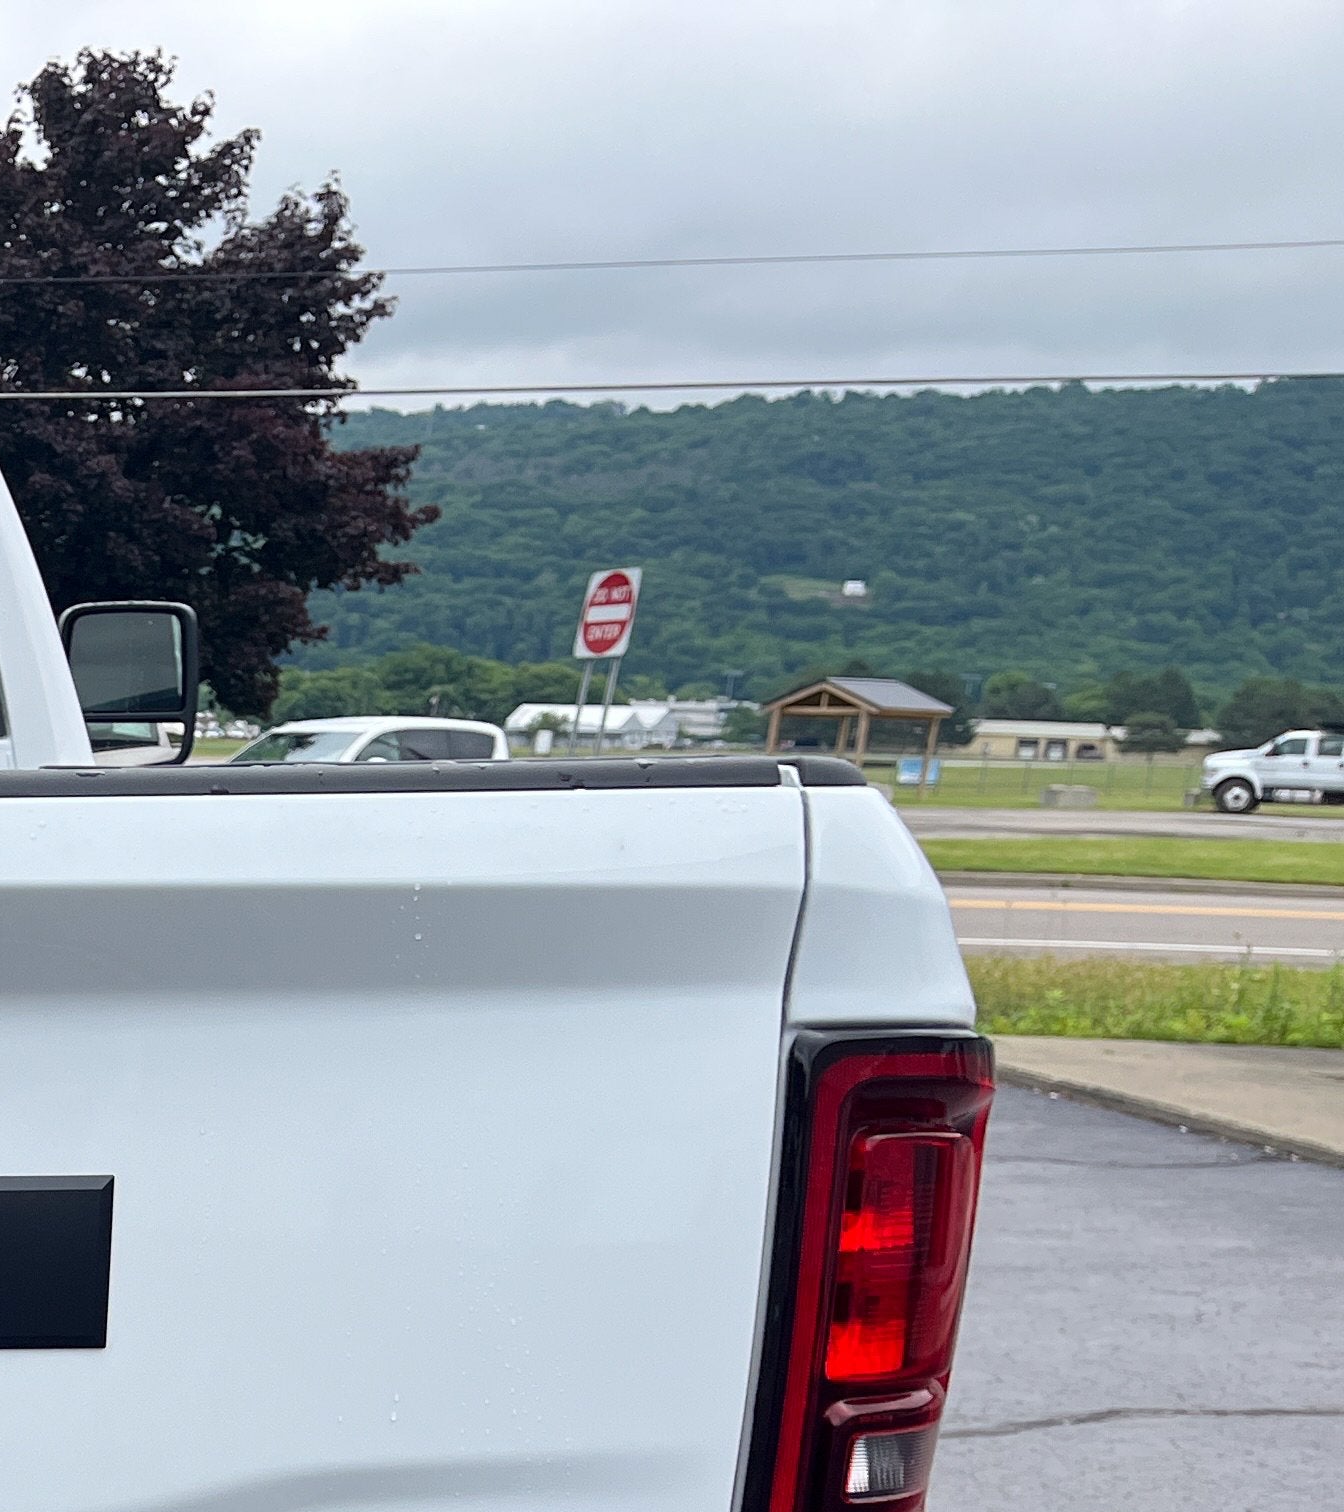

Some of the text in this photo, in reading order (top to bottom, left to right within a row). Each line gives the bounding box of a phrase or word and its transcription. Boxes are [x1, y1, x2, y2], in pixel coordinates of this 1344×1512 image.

[593, 585, 631, 603] DO NOT
[587, 623, 622, 641] ENTER
